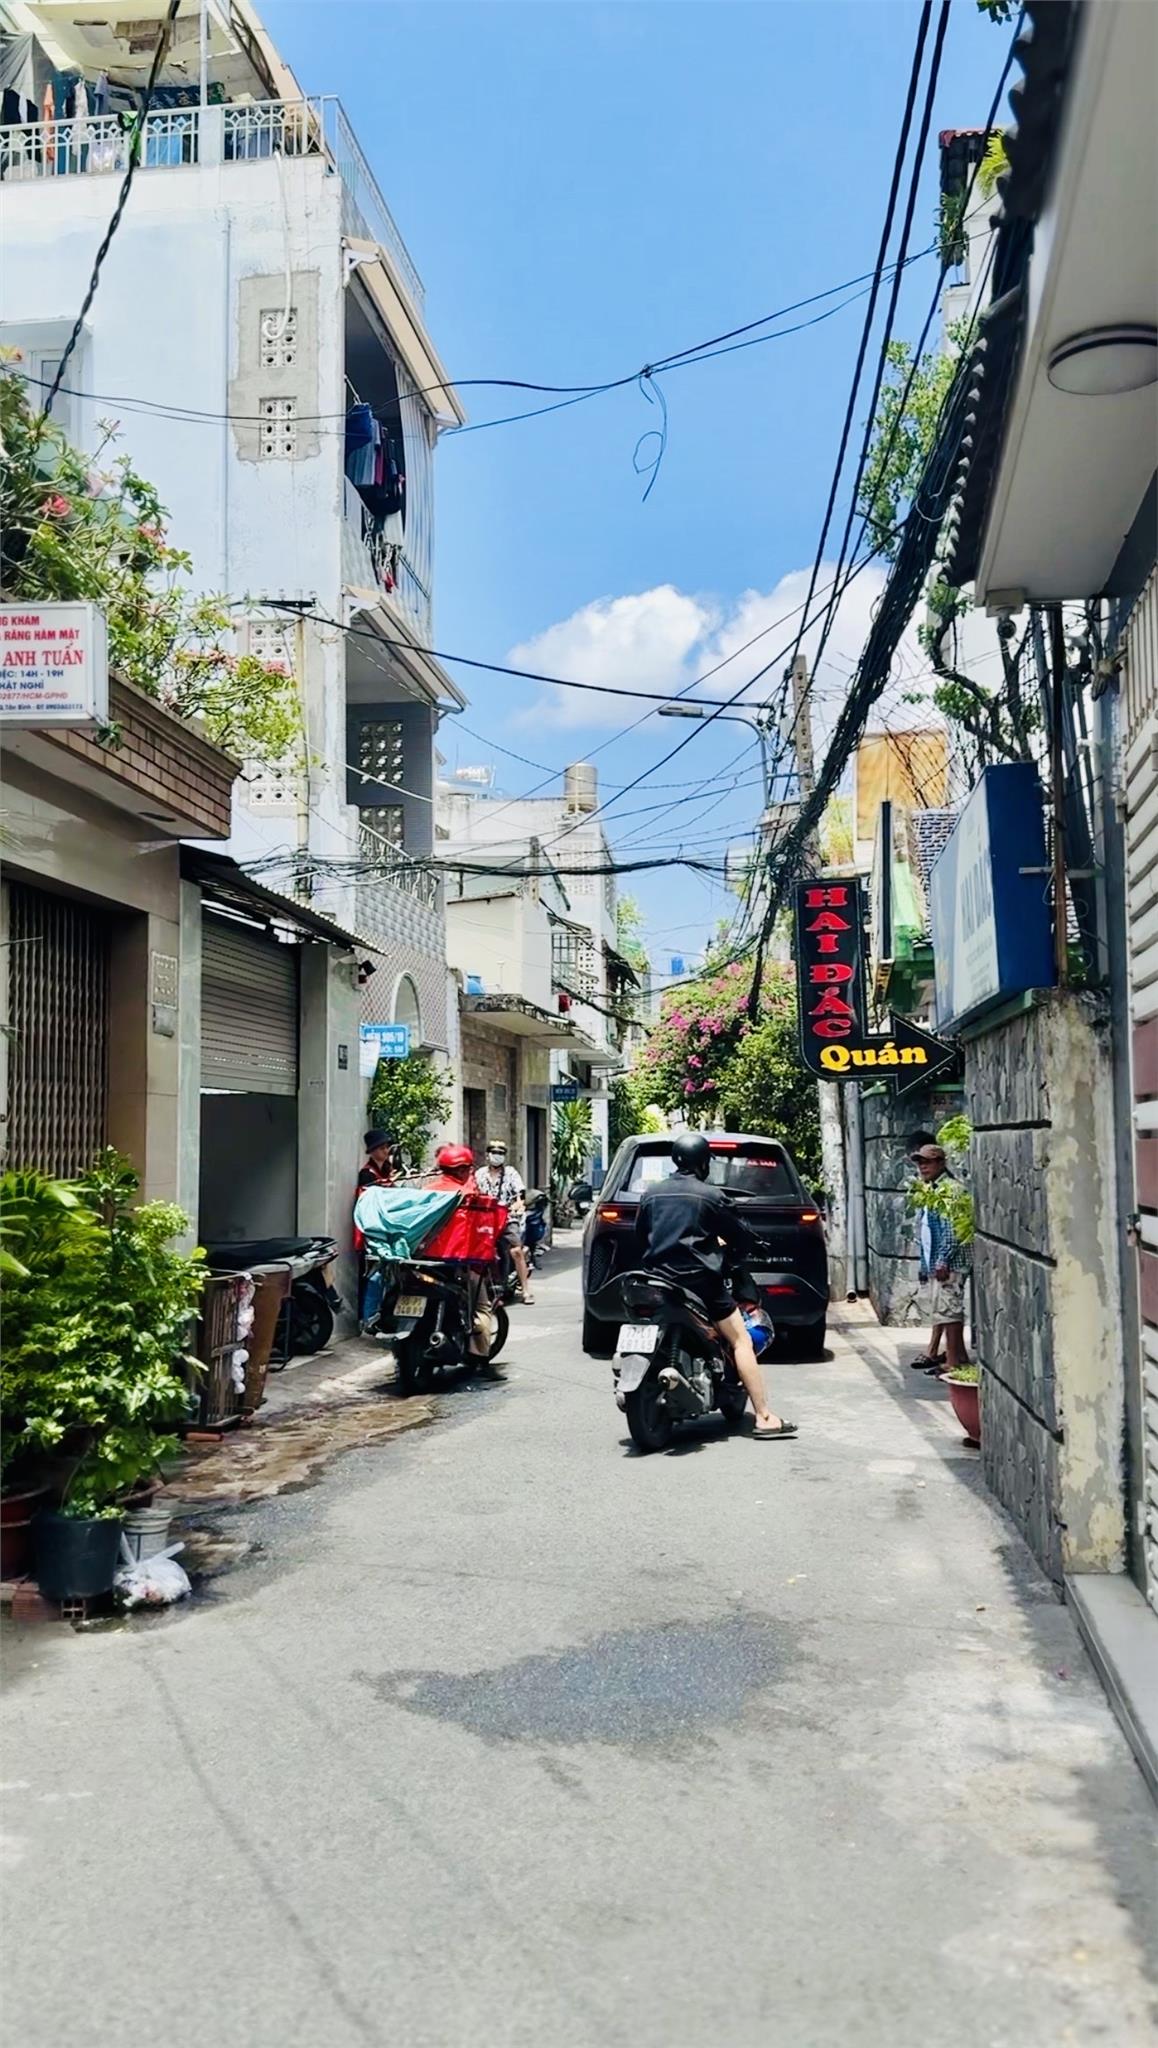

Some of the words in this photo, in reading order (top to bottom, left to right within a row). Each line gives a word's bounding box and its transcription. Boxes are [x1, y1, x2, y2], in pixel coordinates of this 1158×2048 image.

[3, 651, 36, 666] ANH
[42, 643, 84, 666] TUẤN
[21, 670, 38, 678] 14H
[47, 669, 64, 677] 19H
[805, 887, 853, 954] HAI
[808, 963, 854, 1038] ĐẮC
[820, 1042, 928, 1072] Quán
